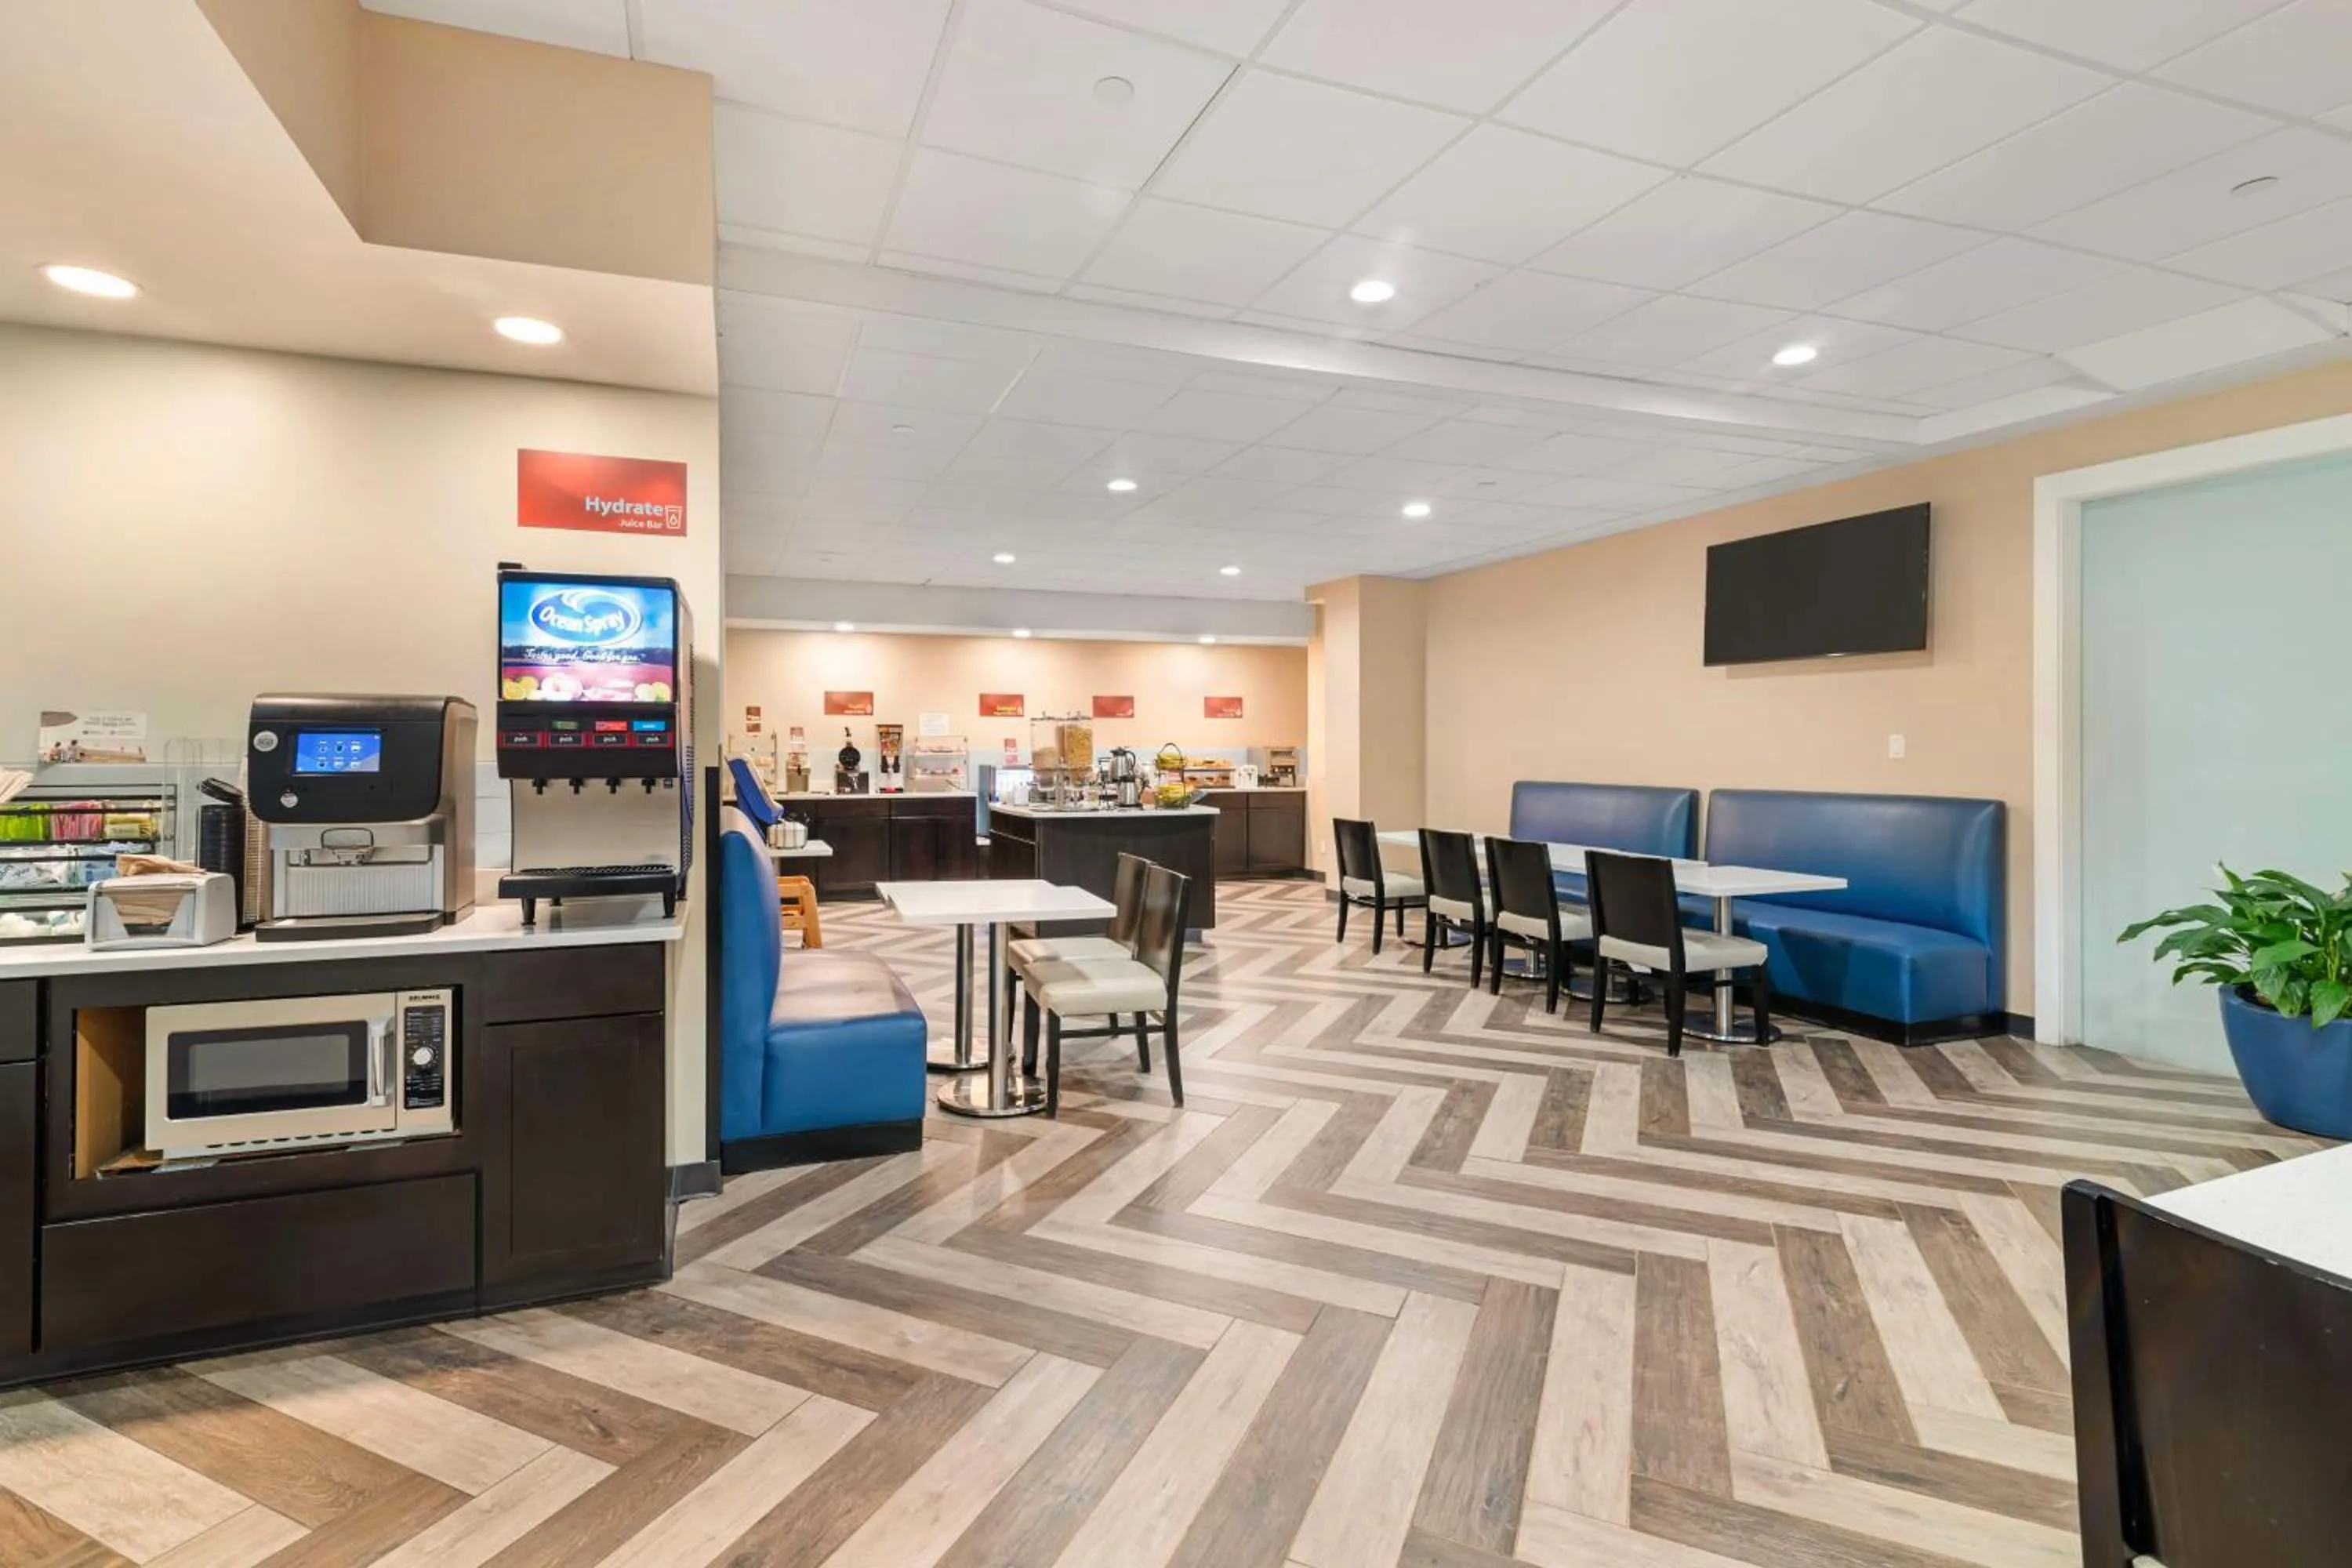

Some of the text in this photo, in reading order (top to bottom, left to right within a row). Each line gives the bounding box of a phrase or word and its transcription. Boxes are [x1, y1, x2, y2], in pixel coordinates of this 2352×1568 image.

[585, 495, 663, 517] Hydrate
[619, 518, 662, 528] Juice Bar
[539, 605, 625, 639] Ocean Spray
